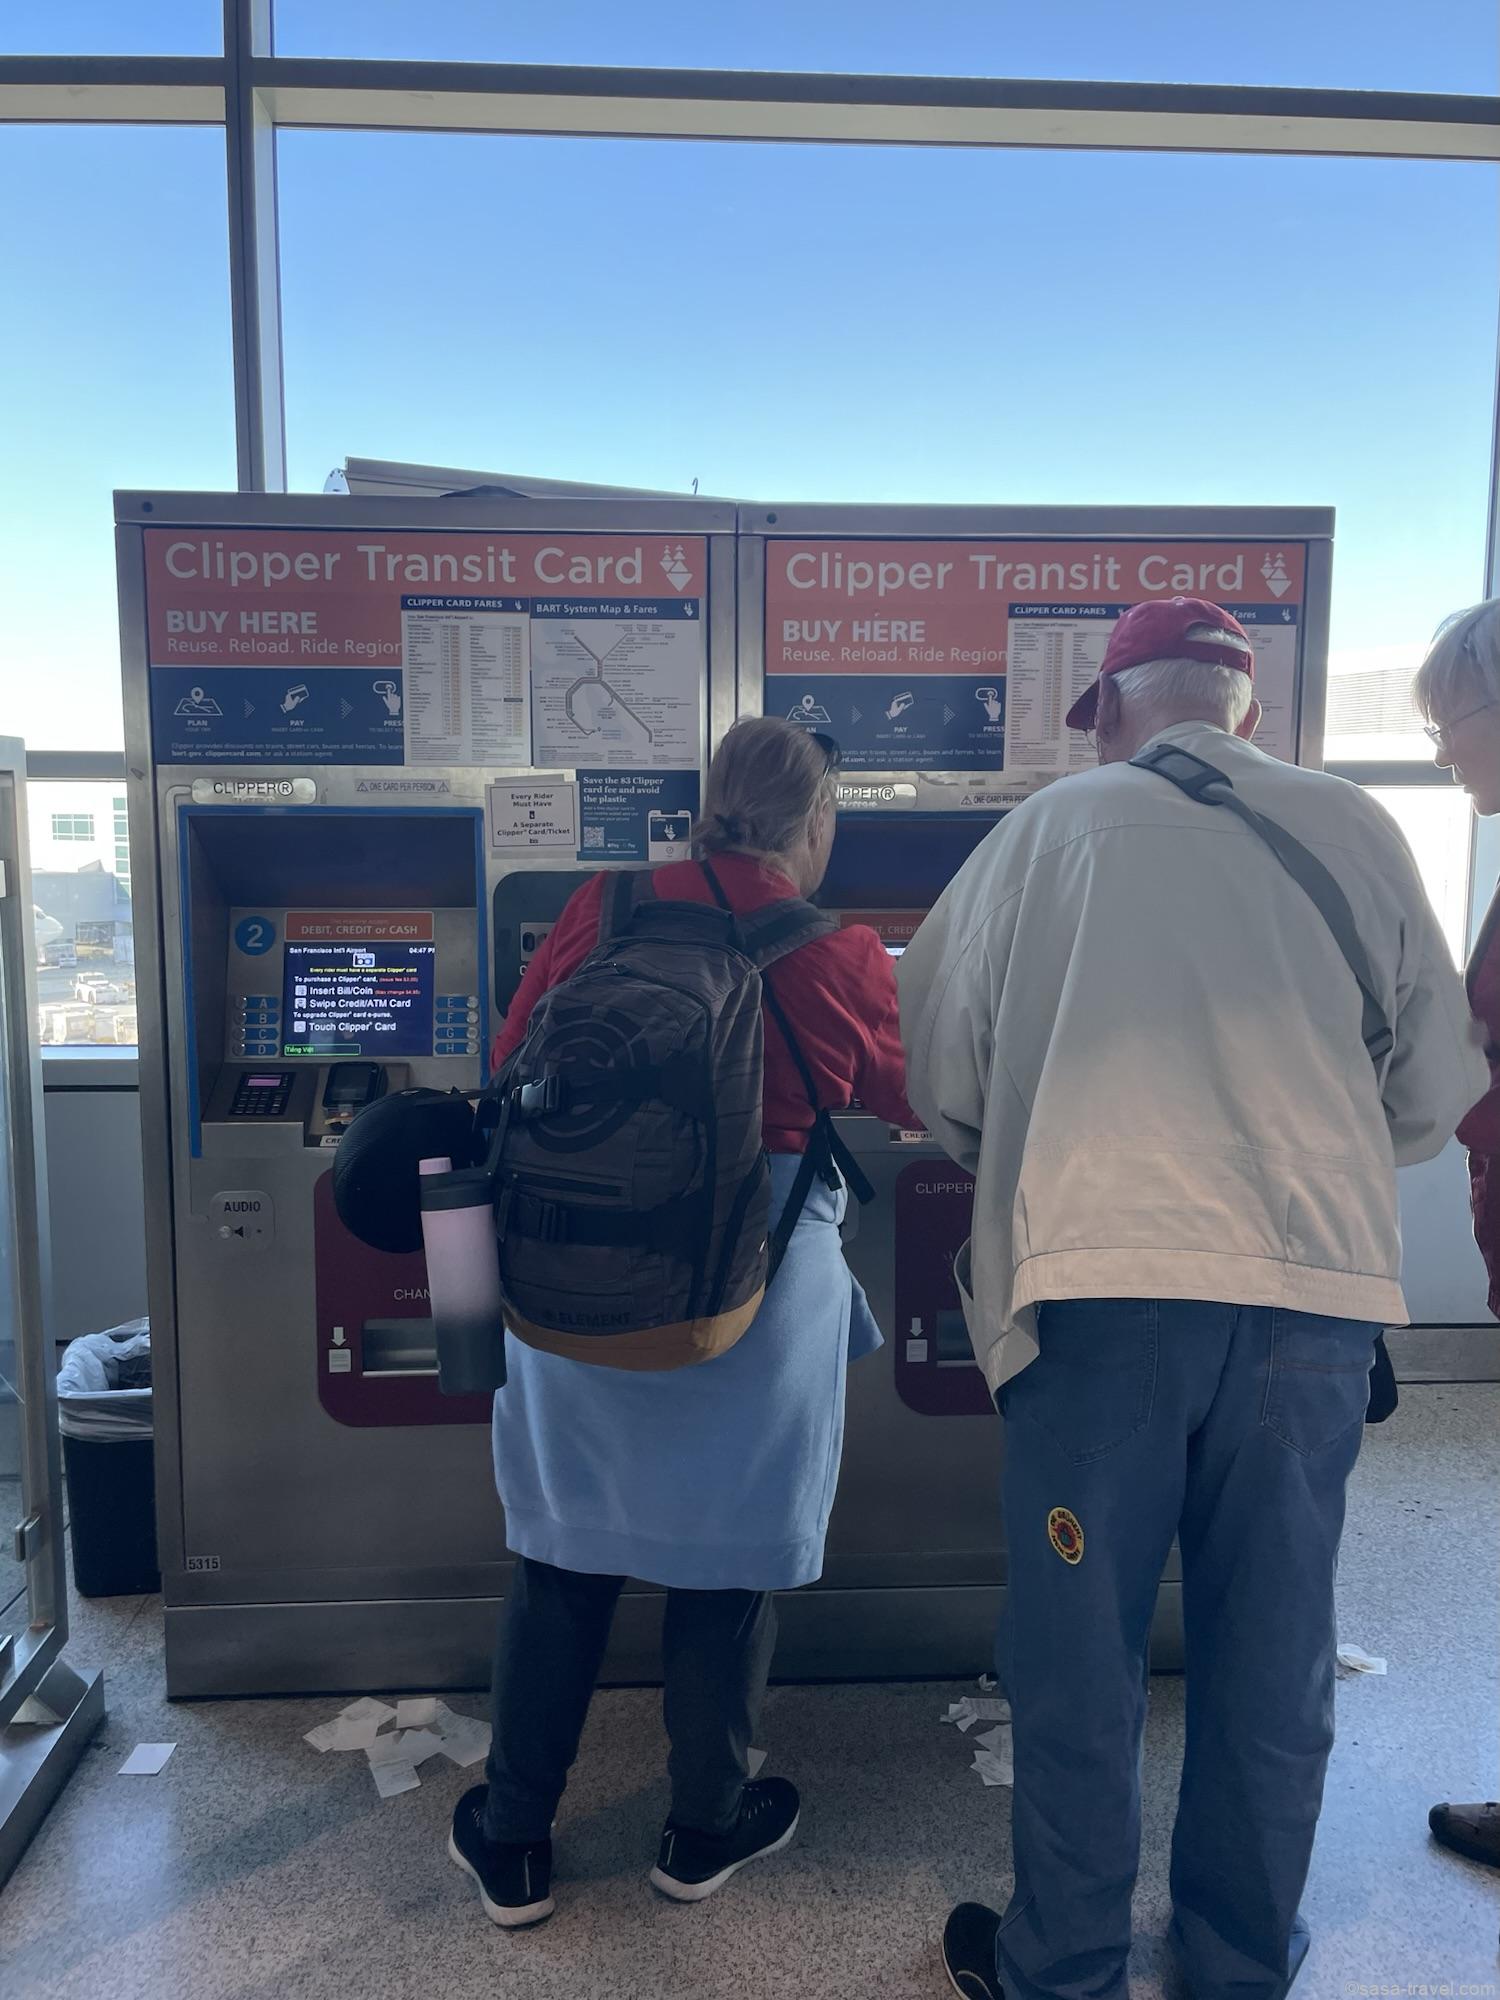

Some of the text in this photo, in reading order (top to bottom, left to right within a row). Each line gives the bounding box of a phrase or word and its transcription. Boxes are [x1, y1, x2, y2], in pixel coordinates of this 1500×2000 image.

[165, 541, 643, 588] Clipper Transit Card
[786, 551, 1245, 597] Clipper Transit Card
[407, 599, 502, 608] CLIPPER CARD FARES
[536, 604, 658, 615] BART System Map & Fares
[1014, 606, 1106, 616] CLIPPER CARD FARES
[1232, 609, 1257, 619] Fares
[166, 610, 318, 635] BUY HERE
[783, 619, 926, 643] BUY HERE
[167, 638, 403, 658] Reuse. Reload. Ride Region
[783, 647, 1007, 665] Reuse. Reload. Ride Region
[187, 719, 208, 727] PLAN
[289, 719, 305, 727] PAY
[369, 782, 436, 792] ONE CARD PER PERSON
[582, 776, 604, 785] Save
[604, 776, 619, 785] the
[632, 776, 665, 787] Clipper
[583, 785, 660, 794] card fee and avoid
[838, 785, 896, 801] IPPER®
[511, 793, 531, 801] Every
[583, 795, 627, 805] the plastic
[973, 794, 988, 804] ONE
[989, 794, 1002, 804] CARD
[1003, 794, 1013, 804] PER
[520, 821, 554, 830] Separate
[528, 828, 570, 836] Card/Ticket
[246, 924, 265, 948] 2
[301, 925, 418, 936] DEBIT, CREDIT or CASH
[346, 947, 367, 956] Airport
[295, 975, 303, 983] To
[304, 975, 331, 985] purchase
[309, 986, 374, 996] Insert Bill/Coin
[259, 998, 268, 1009] A
[309, 999, 412, 1010] Swipe Credit/ATM Card
[447, 997, 455, 1009] E
[259, 1013, 268, 1024] B
[302, 1011, 327, 1020] upgrade
[447, 1013, 455, 1023] F
[309, 1022, 336, 1031] Touch
[374, 1022, 397, 1031] Card
[259, 1028, 267, 1040] C
[446, 1028, 455, 1039] G
[258, 1044, 267, 1055] D
[446, 1043, 455, 1054] H
[223, 1200, 262, 1213] AUDIO
[393, 1288, 431, 1301] CHAN
[559, 1311, 632, 1328] ELEMENT
[188, 1557, 219, 1570] 5315
